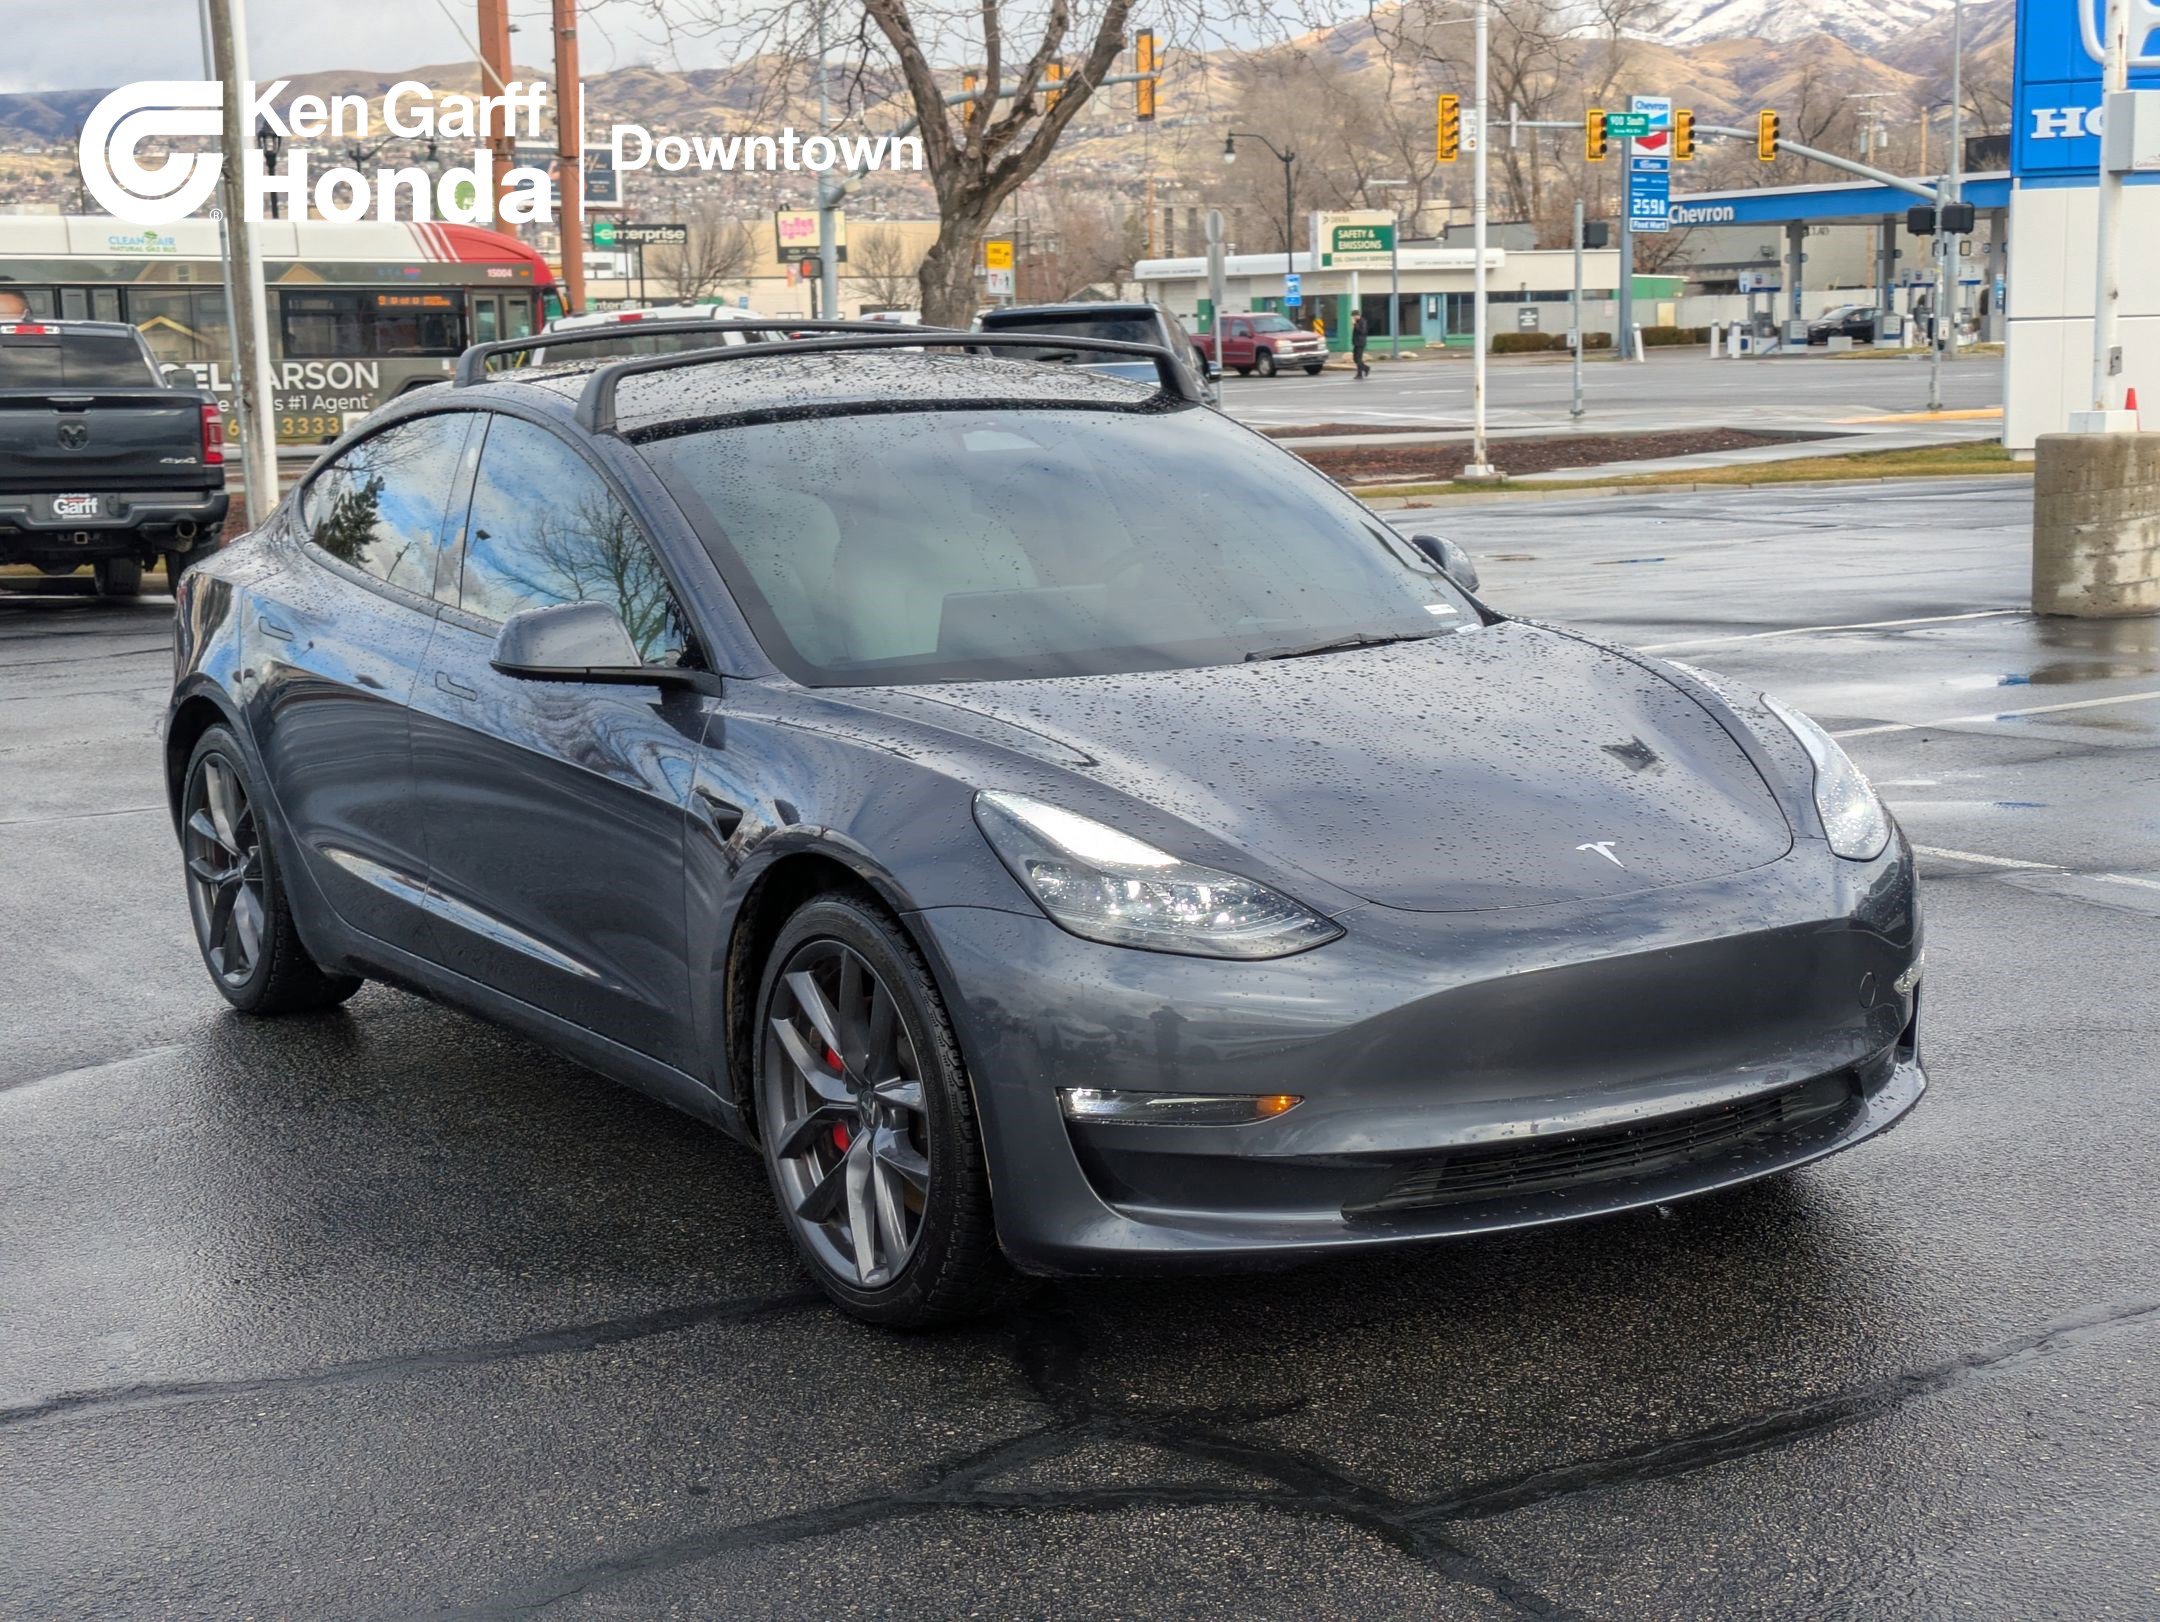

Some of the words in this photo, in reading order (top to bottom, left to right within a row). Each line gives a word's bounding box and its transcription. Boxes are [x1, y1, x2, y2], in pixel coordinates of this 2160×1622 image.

[1635, 101, 1669, 110] Chevron
[1668, 205, 1734, 224] Chevron
[1338, 229, 1366, 239] SAFETY
[1367, 229, 1376, 239] &
[108, 236, 145, 246] CLEAN
[157, 236, 176, 246] AIR
[1338, 240, 1382, 250] EMISSIONS
[312, 394, 369, 414] Agent
[53, 497, 98, 515] Garff
